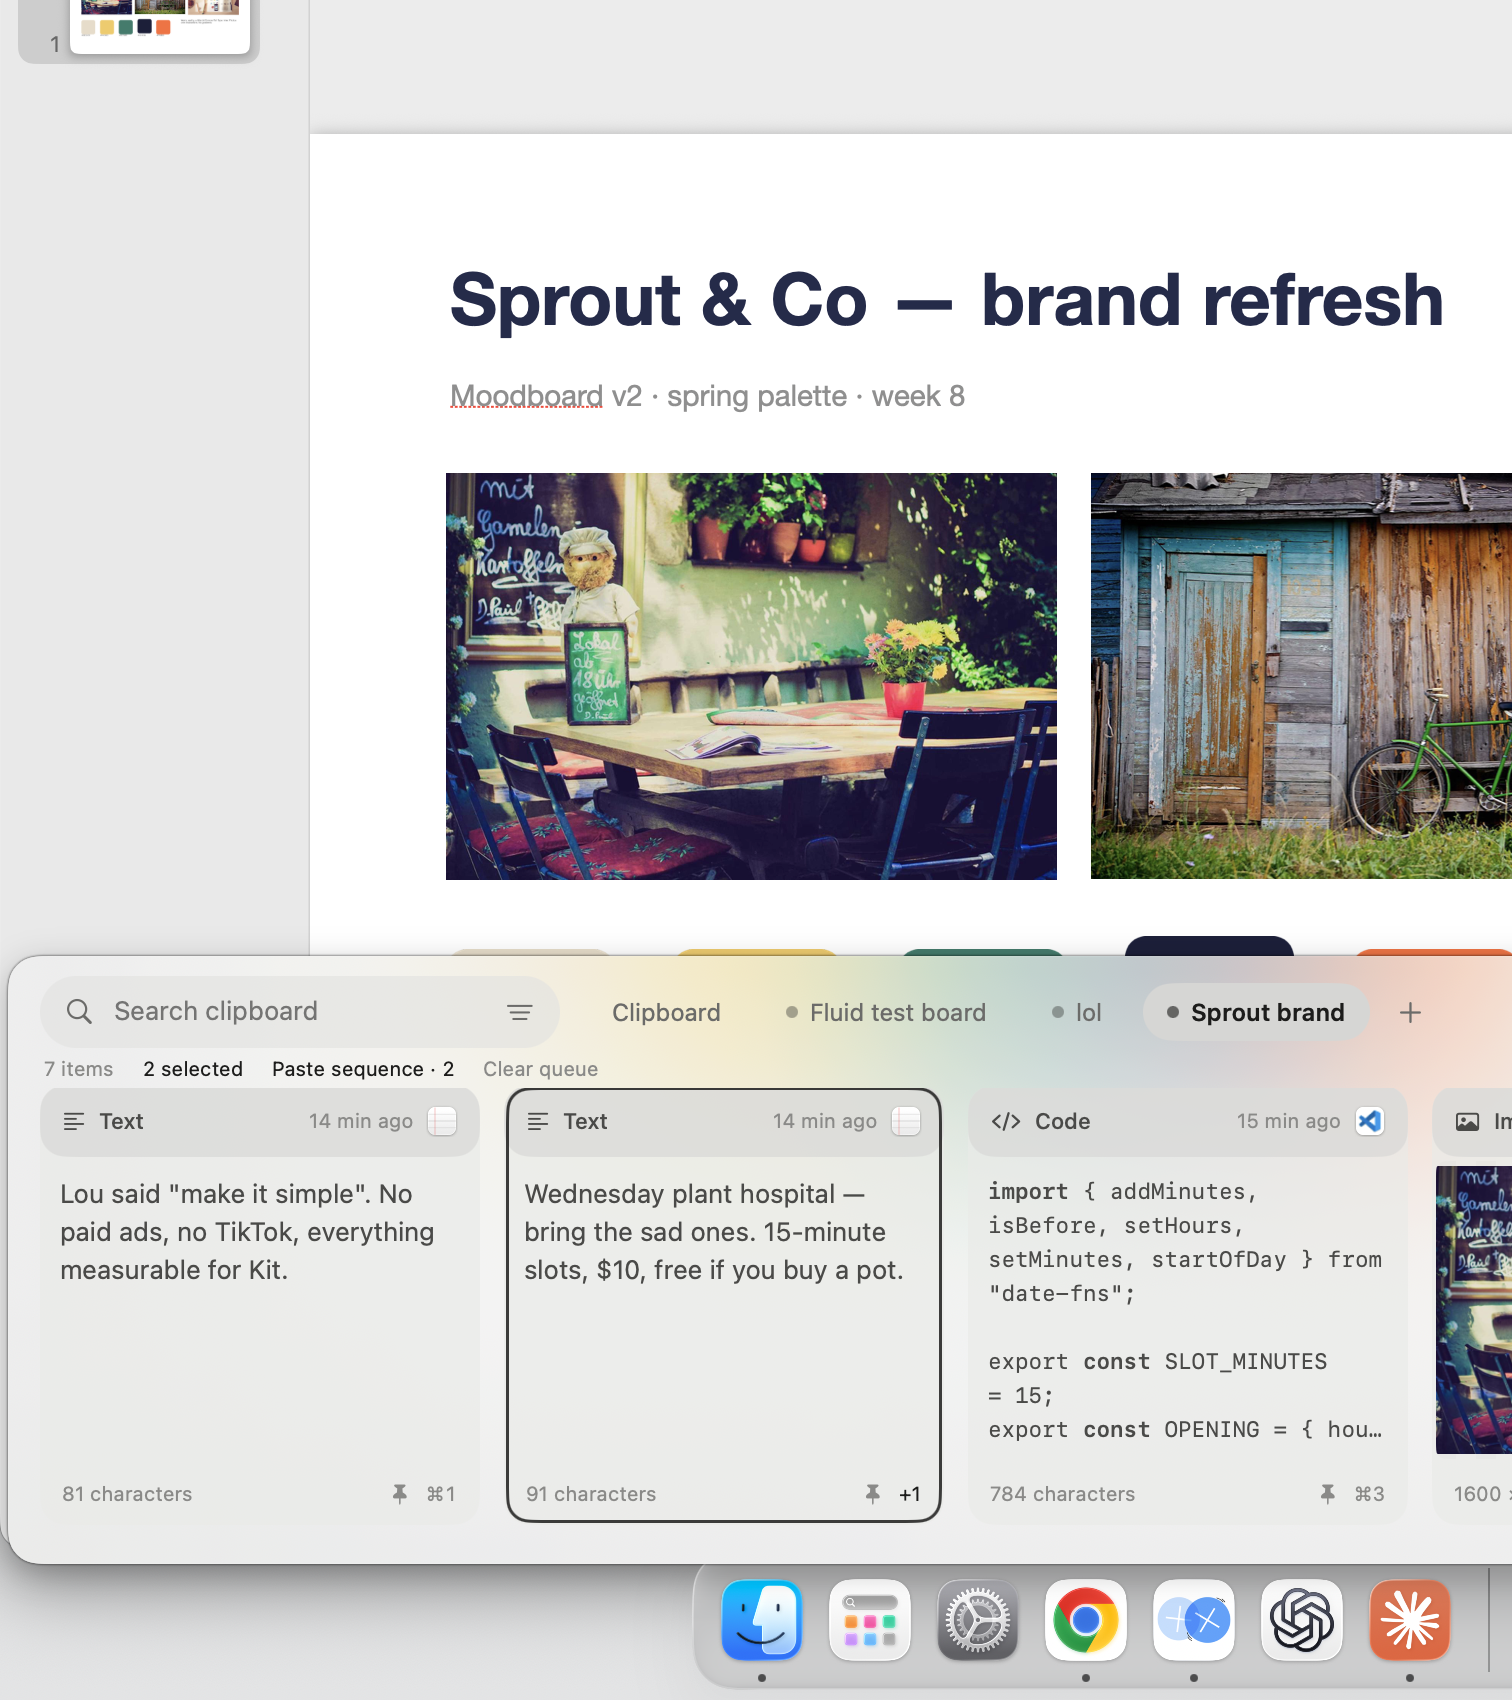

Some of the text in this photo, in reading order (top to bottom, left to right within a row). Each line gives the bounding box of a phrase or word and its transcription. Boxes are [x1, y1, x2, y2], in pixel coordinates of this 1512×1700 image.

[50, 35, 59, 53] 1
[450, 270, 1443, 339] Sprout & Co brand refresh
[449, 383, 966, 413] Moodboard v2 spring palette week 8
[480, 474, 535, 500] mit
[573, 631, 622, 652] Lokal
[573, 651, 594, 669] ab
[572, 669, 593, 689] 18
[114, 999, 318, 1026] Search clipboard
[612, 1002, 721, 1026] Clipboard
[811, 1002, 986, 1022] Fluid test board
[1077, 1002, 1101, 1022] lol
[1191, 1002, 1345, 1026] Sprout brand
[44, 1060, 114, 1077] 7 items
[143, 1060, 243, 1077] 2 selected
[272, 1060, 455, 1081] Paste sequence 2
[483, 1060, 599, 1081] Clear queue
[99, 1112, 144, 1130] Text
[309, 1112, 414, 1133] 14 min ago
[563, 1112, 608, 1130] Text
[1035, 1111, 1091, 1131] Code
[1237, 1112, 1341, 1133] 15 min ago
[61, 1182, 413, 1209] Lou said "make it simple". No
[524, 1182, 835, 1209] Wednesday plant hospital
[989, 1180, 1255, 1204] import addMinutes,
[61, 1220, 434, 1247] paid ads, no TikTok, everything
[525, 1220, 886, 1247] bring the sad ones. 15-minute
[989, 1214, 1241, 1238] isBefore, setHours,
[61, 1258, 288, 1280] measurable for Kit.
[989, 1248, 1382, 1272] setMinutes, startOfDay from
[524, 1257, 903, 1285] slots, $10, free if you buy a pot.
[989, 1352, 1328, 1374] export const SLOT_MINUTES
[1015, 1386, 1052, 1408] 15;
[1164, 1420, 1260, 1438] OPENING
[62, 1485, 193, 1502] 81 characters
[899, 1485, 920, 1502] +1
